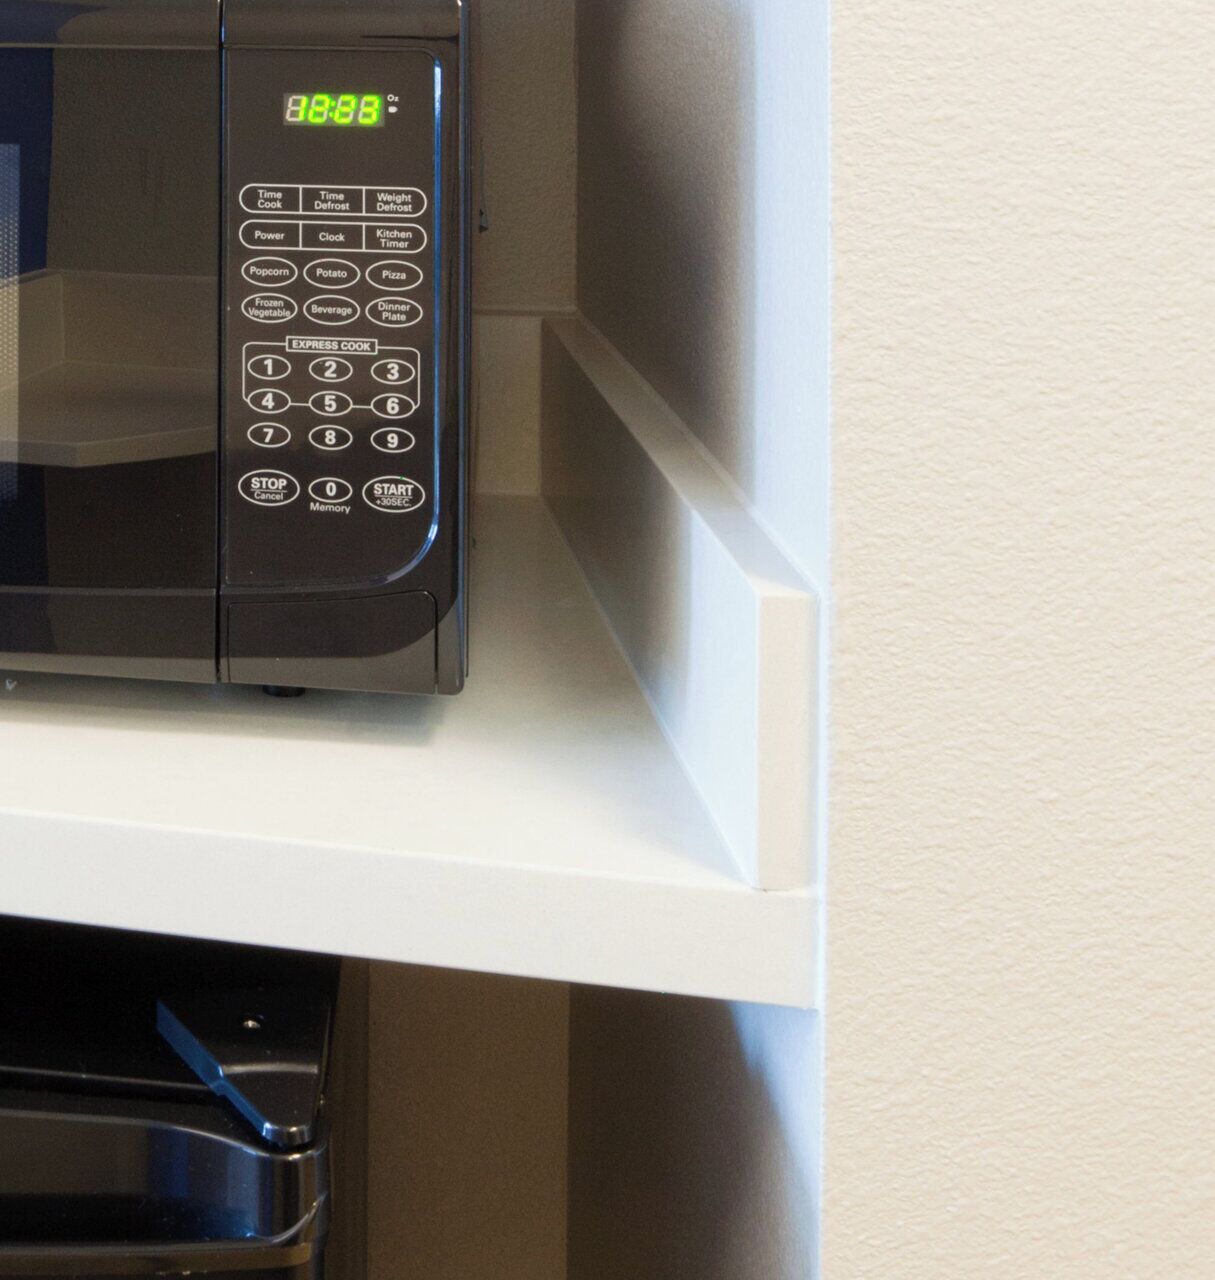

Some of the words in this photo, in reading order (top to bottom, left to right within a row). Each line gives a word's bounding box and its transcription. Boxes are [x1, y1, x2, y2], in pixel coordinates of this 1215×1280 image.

[297, 93, 382, 124] 12:23
[257, 189, 282, 199] Time
[319, 190, 345, 200] Time
[377, 192, 412, 203] Weight
[257, 199, 283, 209] Cook
[314, 200, 350, 211] Defrost
[376, 202, 413, 212] Defrost
[254, 231, 285, 240] Power
[319, 232, 345, 242] Clock
[376, 229, 412, 239] Kitchen
[380, 239, 409, 249] Timer
[250, 266, 289, 278] Popcorn
[316, 268, 347, 278] Potato
[382, 270, 406, 280] Pizza
[255, 298, 284, 307] Frozen
[378, 302, 411, 311] Dinner
[248, 307, 291, 318] Vegetable
[311, 305, 352, 316] Beverage
[382, 312, 406, 321] Plate
[292, 340, 339, 350] EXPRESS
[340, 342, 371, 351] COOK
[263, 359, 273, 375] 1
[324, 361, 337, 377] 2
[387, 363, 399, 380] 3
[261, 393, 275, 409] 4
[324, 395, 337, 412] 5
[386, 398, 399, 414] 6
[262, 428, 274, 443] 7
[324, 430, 336, 445] 8
[387, 433, 399, 448] 9
[251, 477, 287, 490] STOP
[326, 482, 337, 496] 0
[374, 484, 414, 496] START
[254, 491, 284, 501] Cancel
[310, 502, 351, 514] Memory
